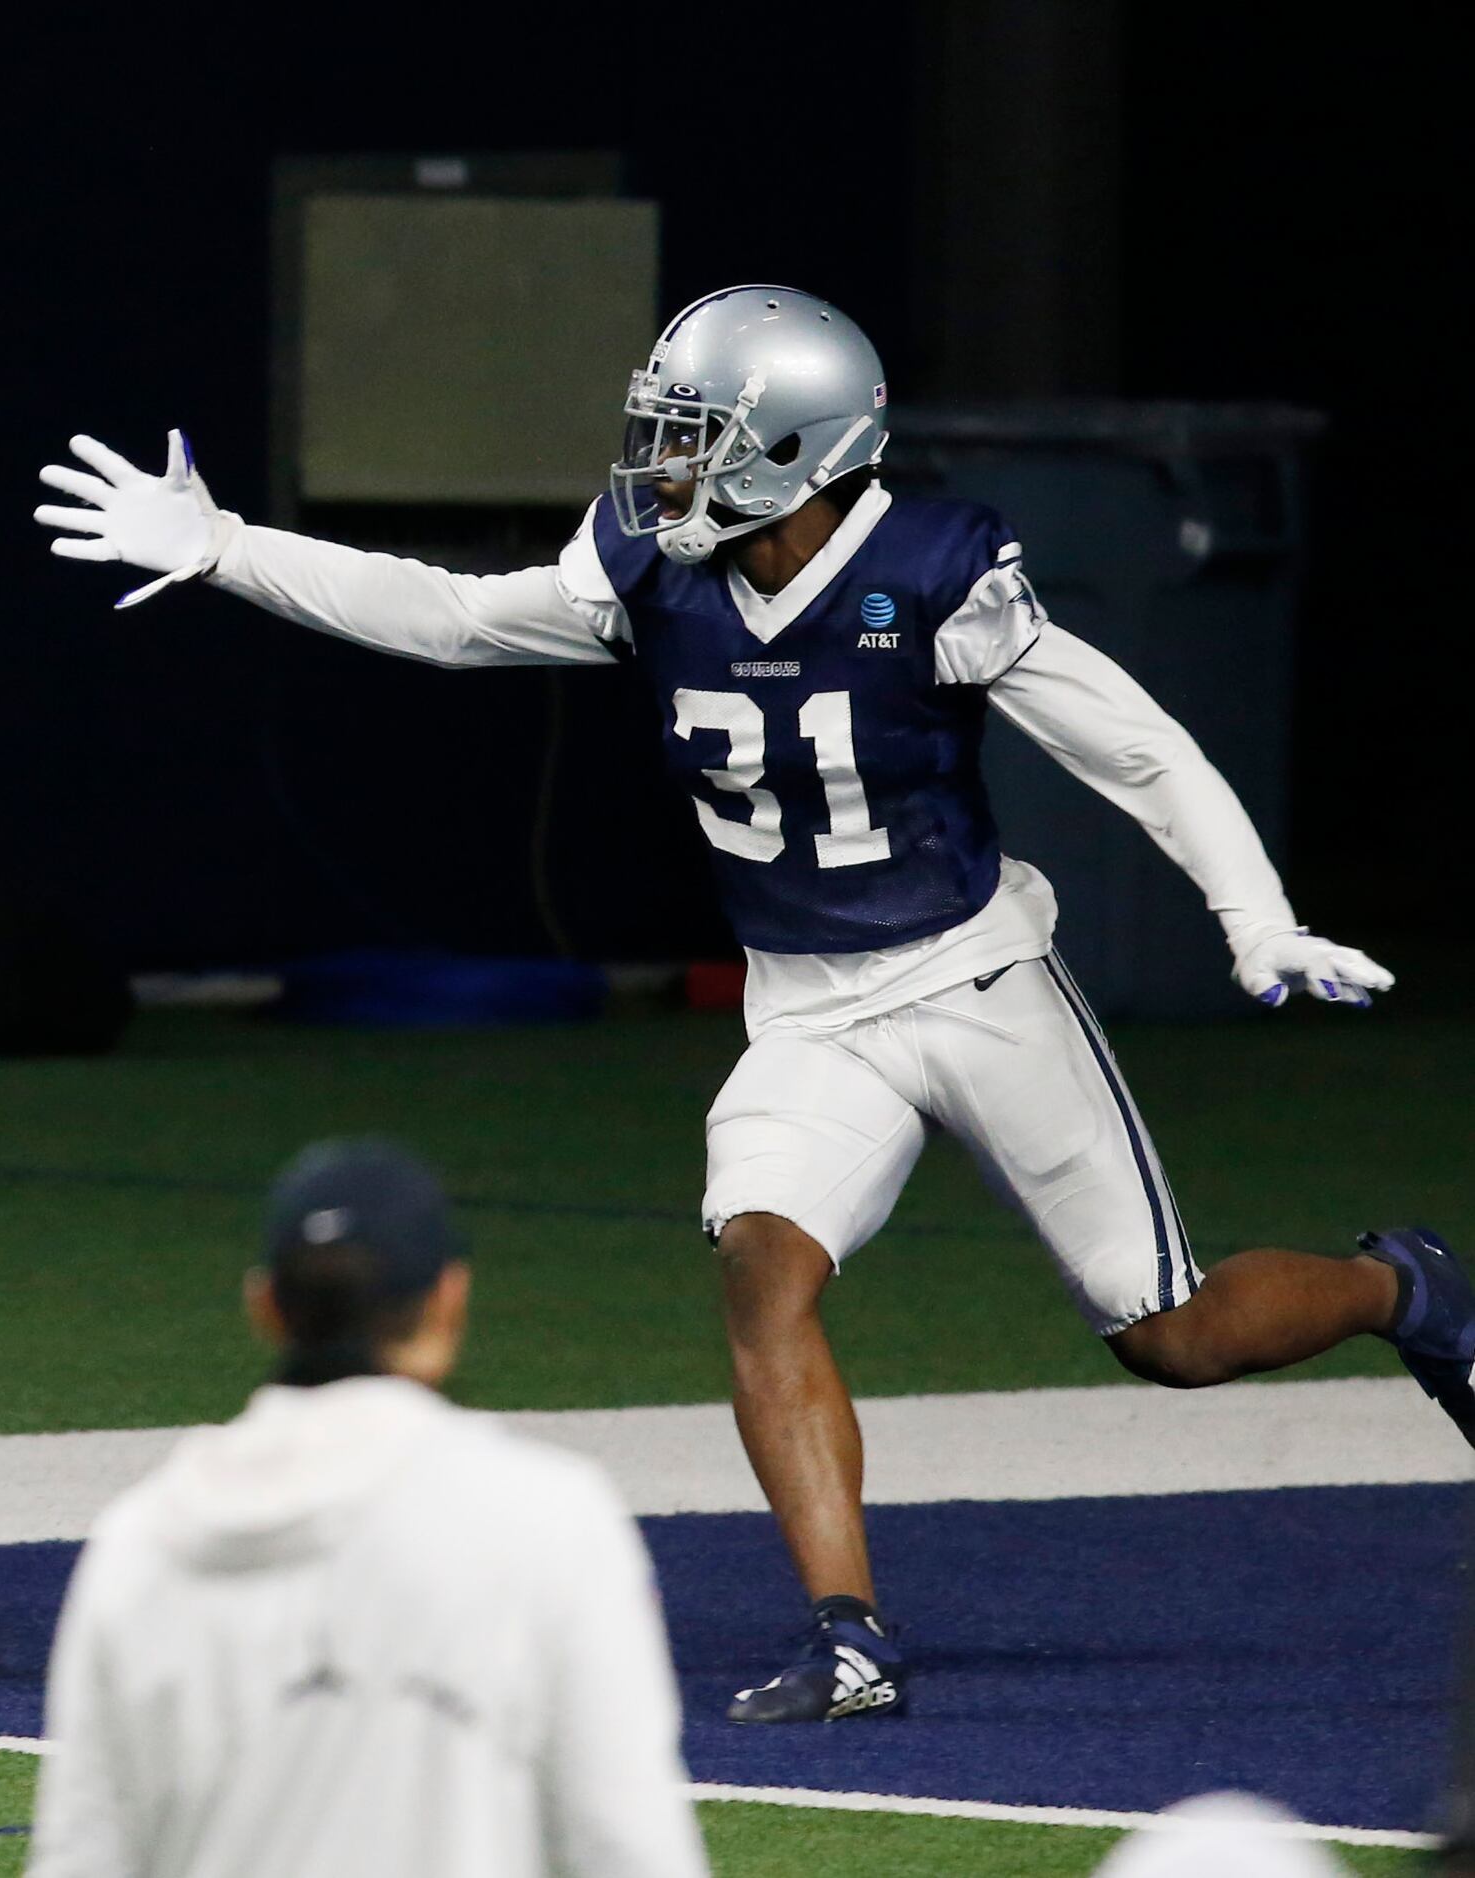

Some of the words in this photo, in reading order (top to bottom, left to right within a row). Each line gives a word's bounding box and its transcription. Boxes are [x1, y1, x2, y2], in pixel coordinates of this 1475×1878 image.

[857, 633, 901, 648] AT&T
[731, 661, 801, 677] COWBOYS
[672, 687, 891, 868] 31
